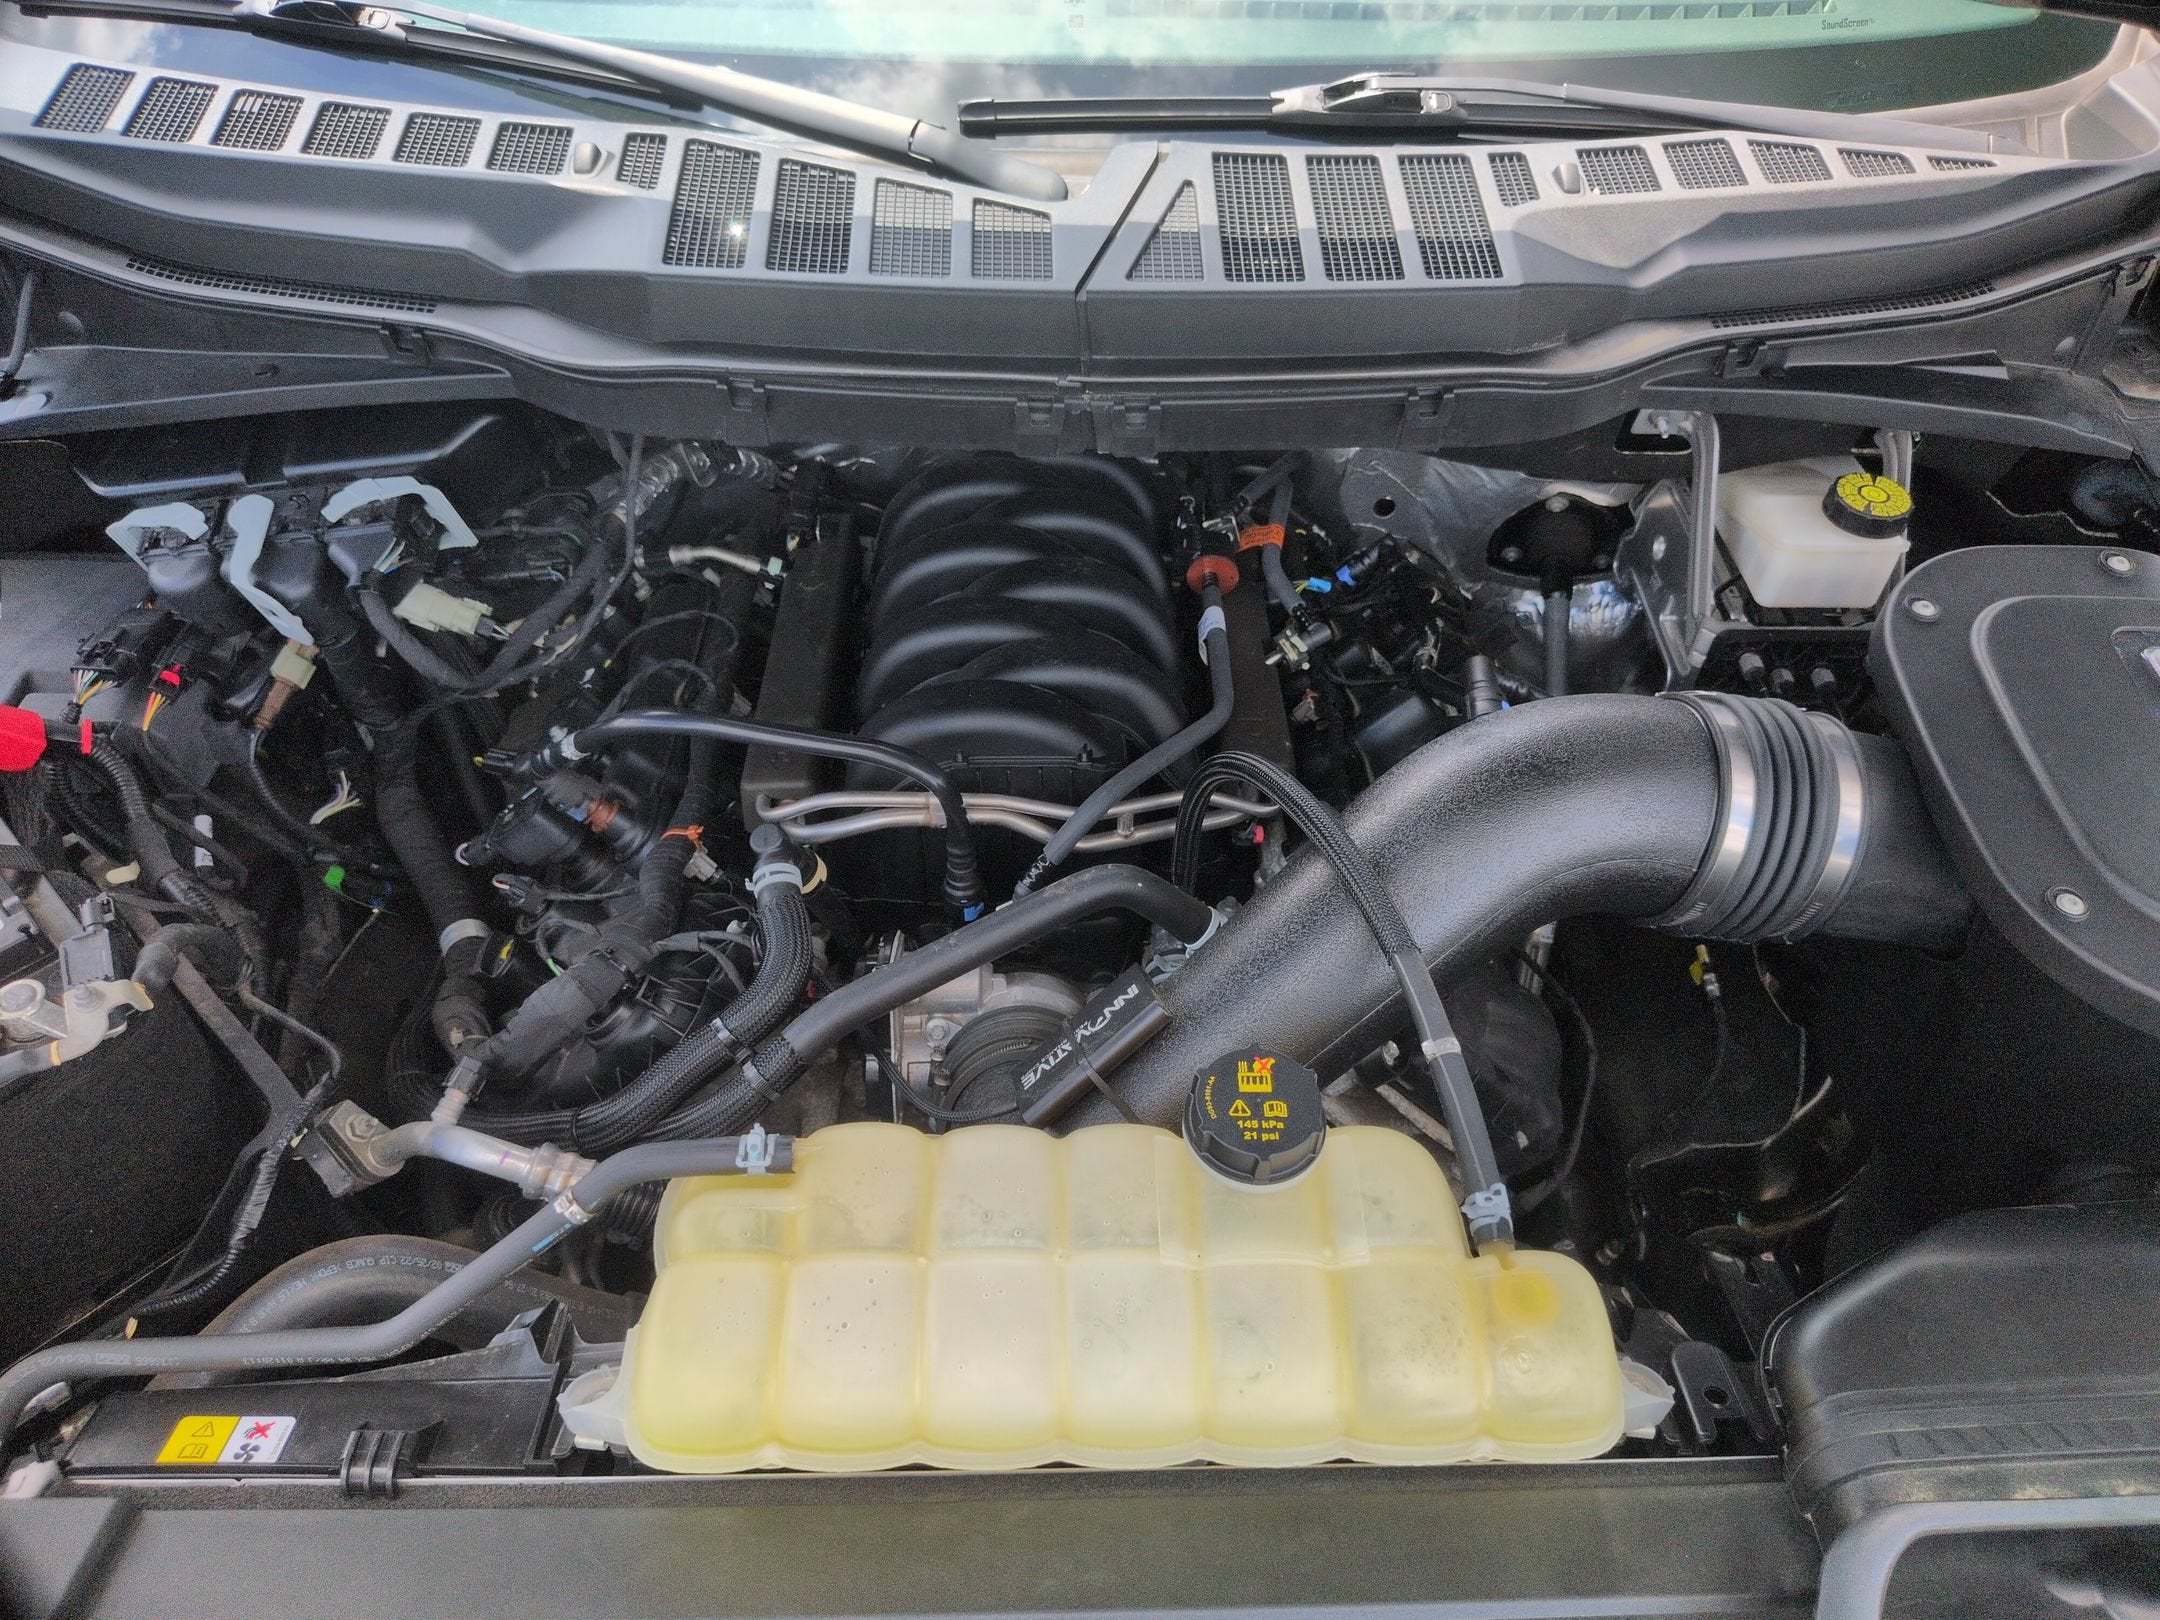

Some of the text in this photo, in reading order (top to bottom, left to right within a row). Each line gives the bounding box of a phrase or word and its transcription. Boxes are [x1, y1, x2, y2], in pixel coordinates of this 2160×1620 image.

[1237, 1120, 1285, 1129] 145 kPa
[1243, 1131, 1280, 1142] 21 psi
